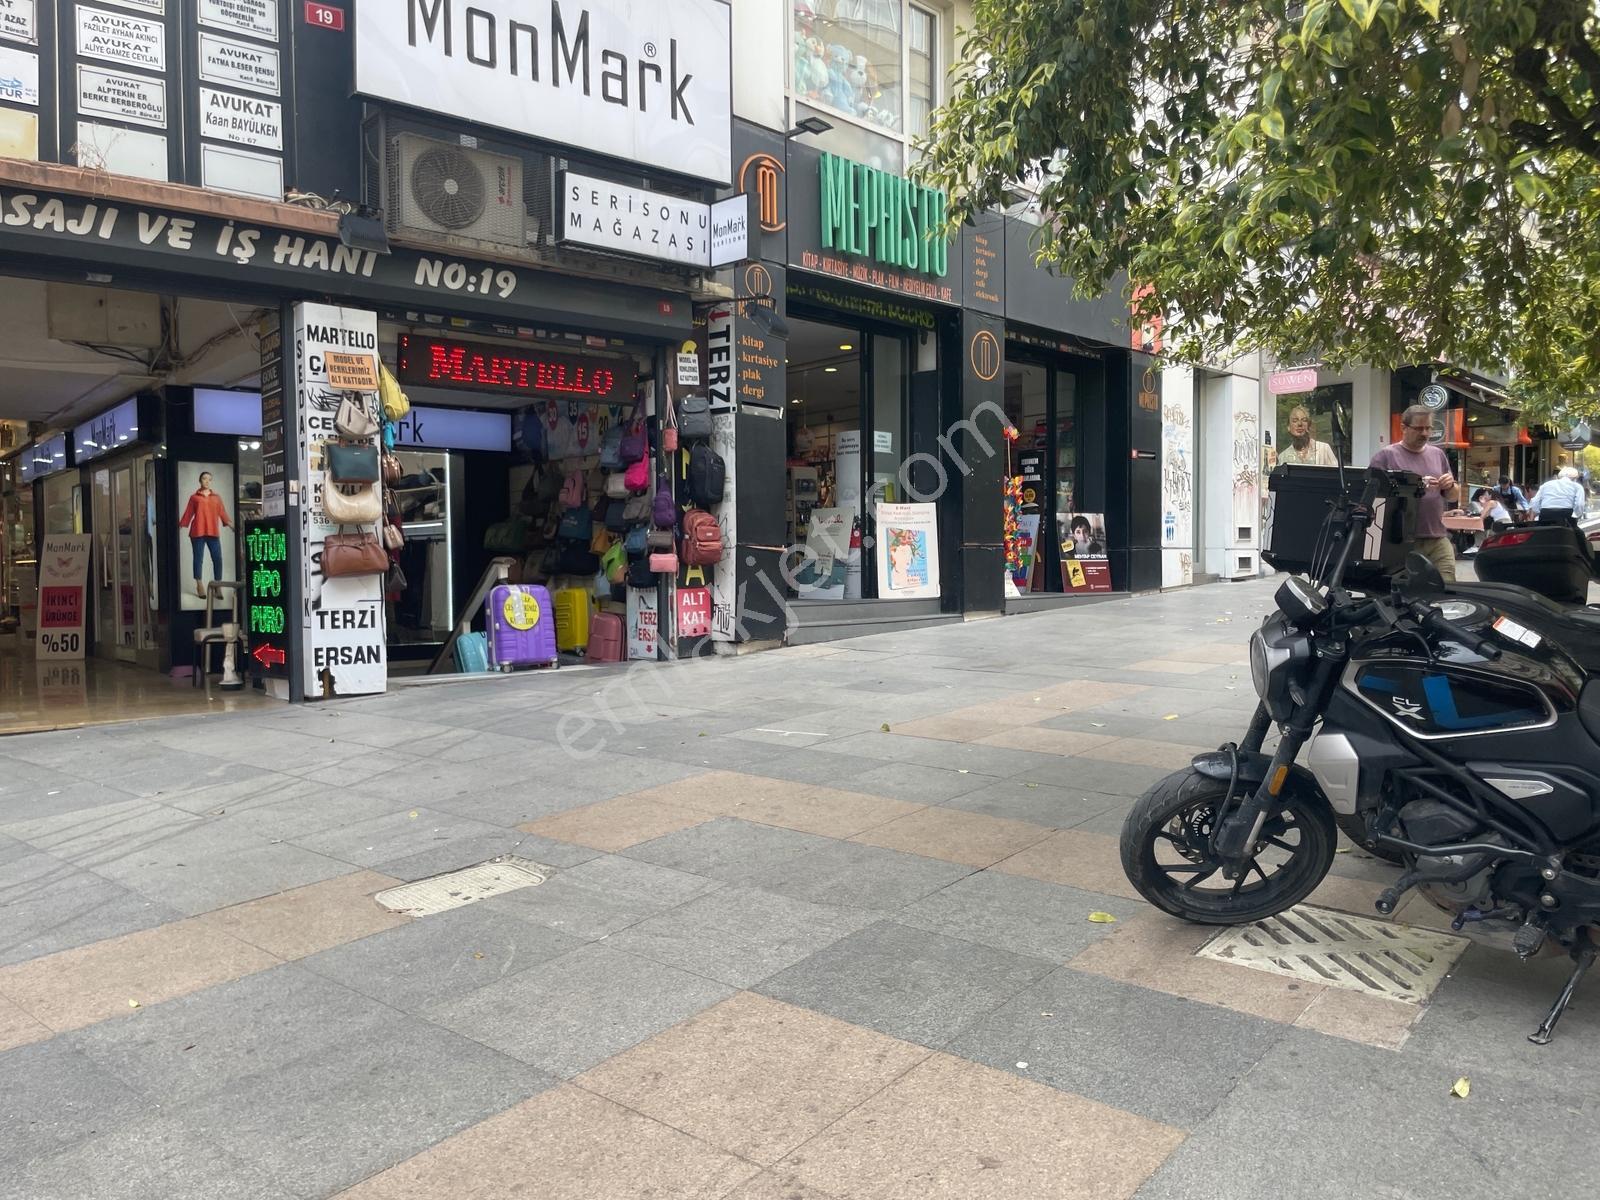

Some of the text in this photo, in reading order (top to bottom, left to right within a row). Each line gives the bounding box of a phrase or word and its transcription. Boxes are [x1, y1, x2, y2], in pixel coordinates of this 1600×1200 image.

[91, 15, 151, 33] AVUKAT
[315, 7, 334, 25] 19
[83, 22, 158, 43] FAZİLET AYHAN AKINCI
[84, 43, 159, 64] ALİYE GAMZE CEYLAN
[92, 36, 152, 53] AVUKAT
[219, 47, 262, 63] AVUKAT
[208, 56, 230, 68] FATMA
[254, 66, 275, 77] ŞENSU
[407, 0, 695, 126] MonMark
[97, 86, 136, 99] ALPTEKİN
[105, 78, 141, 90] AVUKAT
[82, 92, 162, 113] BERKE BERBEROĞLU
[210, 93, 273, 118] AVUKAT
[205, 111, 278, 138] Kaan BAYÜLKEN
[572, 186, 707, 229] SERİSONU
[570, 212, 707, 254] MAĞAZASI
[712, 216, 746, 239] MonMark
[138, 212, 196, 250] VE
[216, 220, 261, 265] İŞ
[273, 234, 378, 278] HANI
[414, 257, 517, 299] NO:19
[802, 250, 819, 270] KİTAP
[822, 256, 849, 278] KIRTASİYE
[852, 263, 868, 282] MÜZİK
[872, 270, 885, 286] PLAK
[306, 324, 375, 350] MARTELLO
[742, 335, 765, 351] kitap
[333, 355, 355, 365] MODEL
[356, 356, 365, 365] VE
[708, 324, 737, 415] TERZİ
[331, 374, 341, 384] ALT
[742, 368, 762, 382] plak
[742, 385, 765, 399] dergi
[246, 528, 287, 562] TÜTÜN
[252, 563, 281, 597] PİPO
[682, 591, 705, 606] ALT
[251, 605, 285, 634] PURO
[315, 606, 376, 630] TERZİ
[682, 610, 706, 626] KAT
[42, 632, 80, 653] %50
[314, 645, 381, 667] ERSAN
